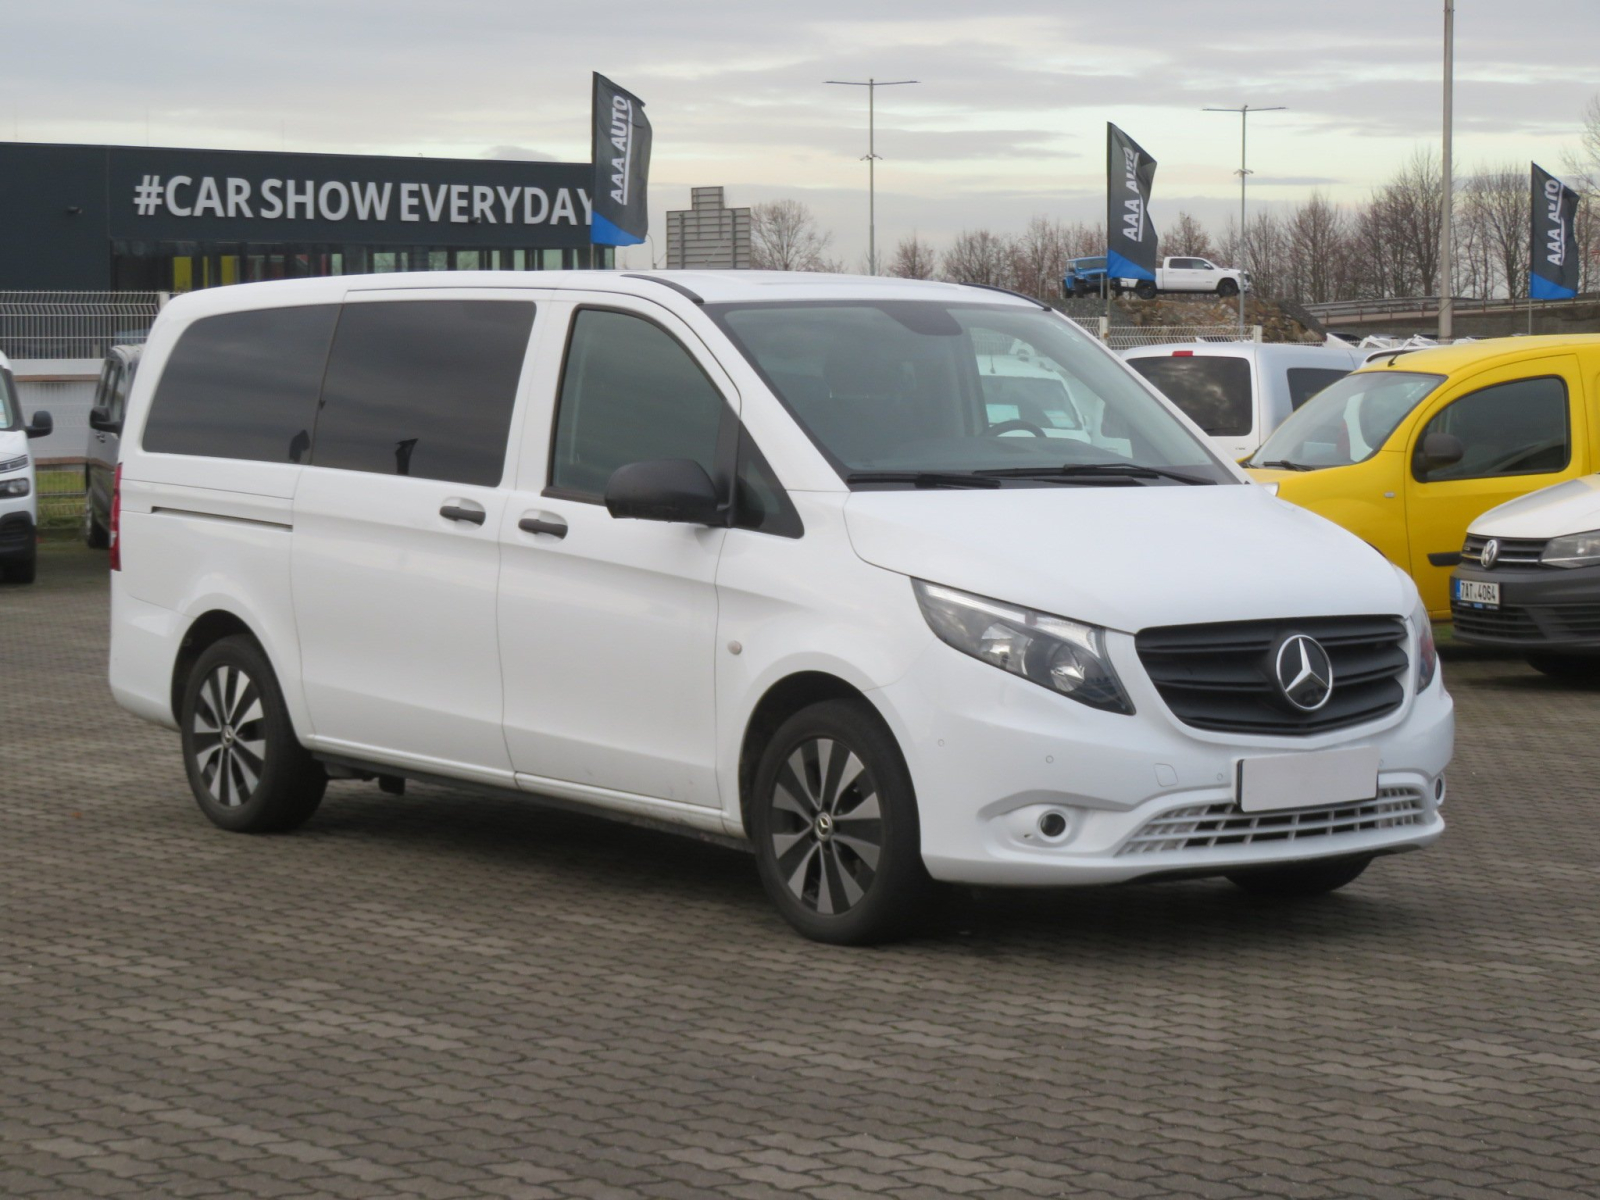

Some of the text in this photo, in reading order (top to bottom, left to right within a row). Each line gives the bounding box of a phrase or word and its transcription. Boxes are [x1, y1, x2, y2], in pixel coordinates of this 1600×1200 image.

[610, 95, 628, 205] AAA AUTO
[133, 174, 592, 226] #CAR SHOW EVERYDAY
[1122, 199, 1139, 242] AAA
[1546, 228, 1562, 266] AAA
